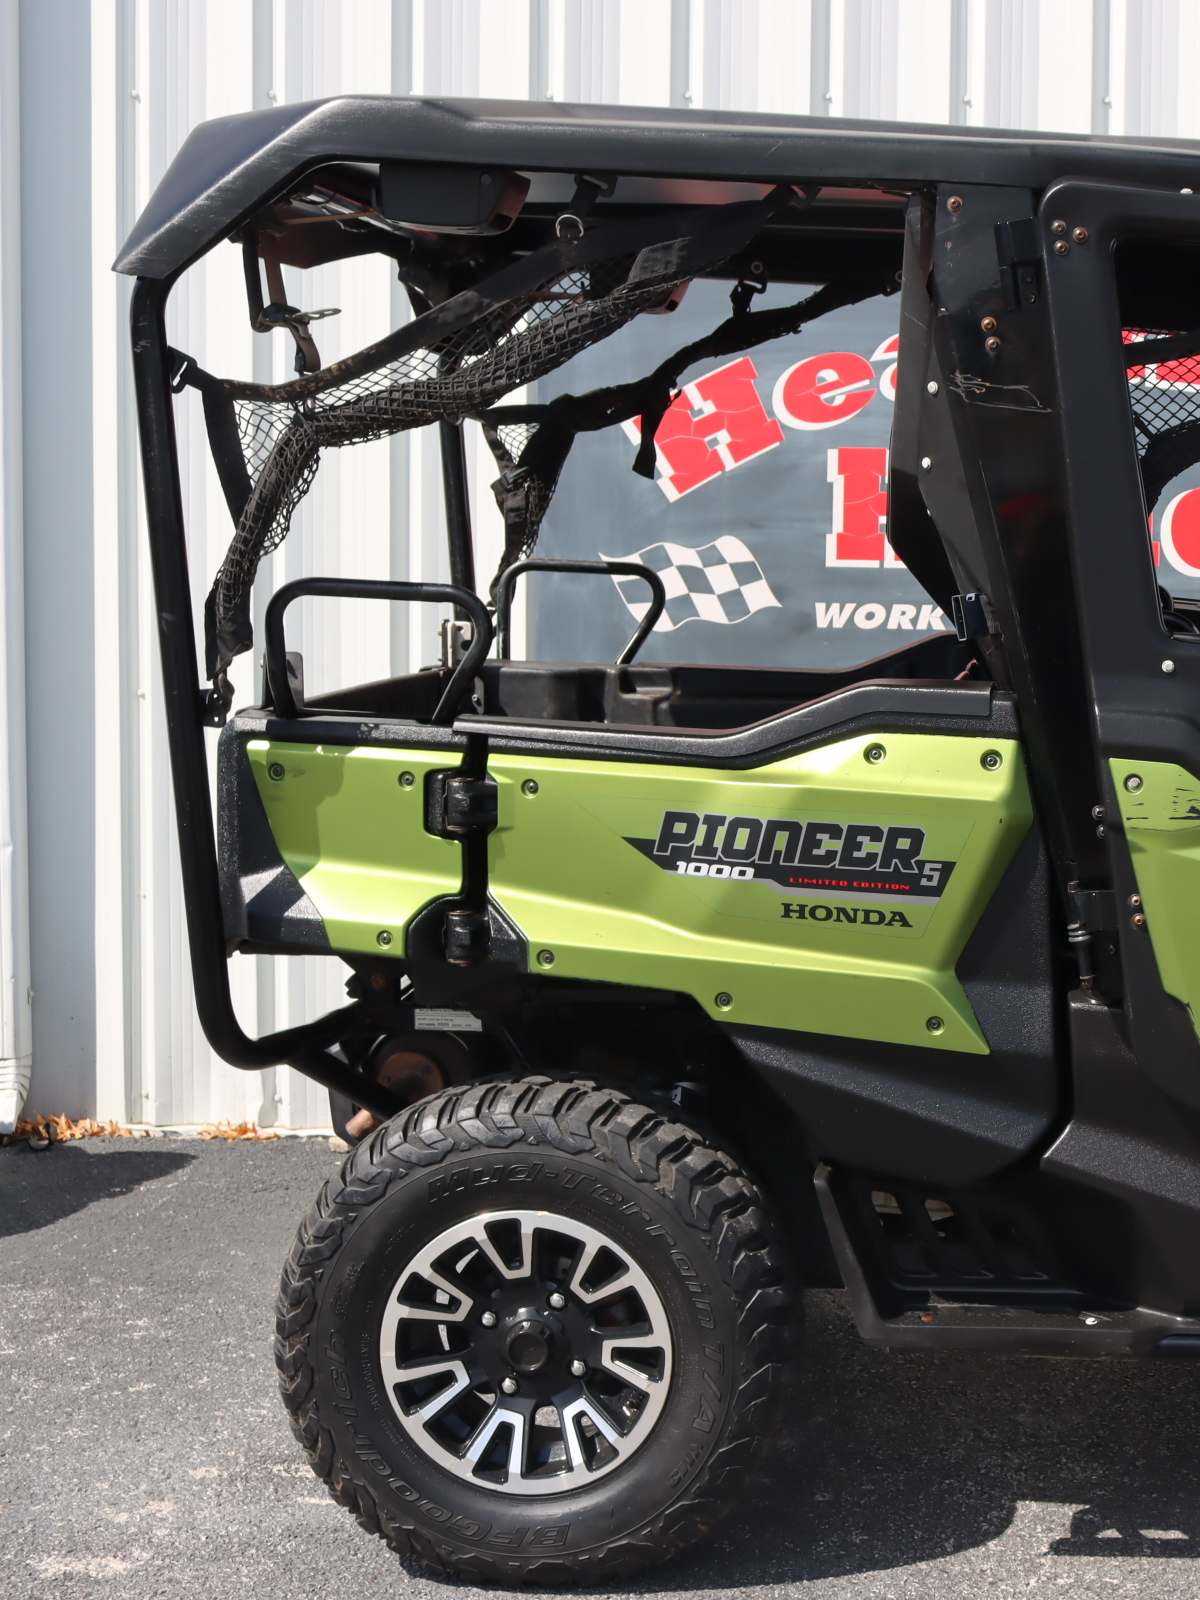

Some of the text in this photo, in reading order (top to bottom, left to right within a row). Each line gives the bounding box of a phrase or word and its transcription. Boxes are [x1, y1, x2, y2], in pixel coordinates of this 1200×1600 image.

[815, 602, 946, 631] WORK
[653, 809, 943, 886] PIONEER 5
[676, 861, 755, 880] 1000
[789, 877, 910, 890] LIMITED EDITION
[781, 902, 913, 928] HONDA
[324, 1331, 572, 1550] BFGoodrich
